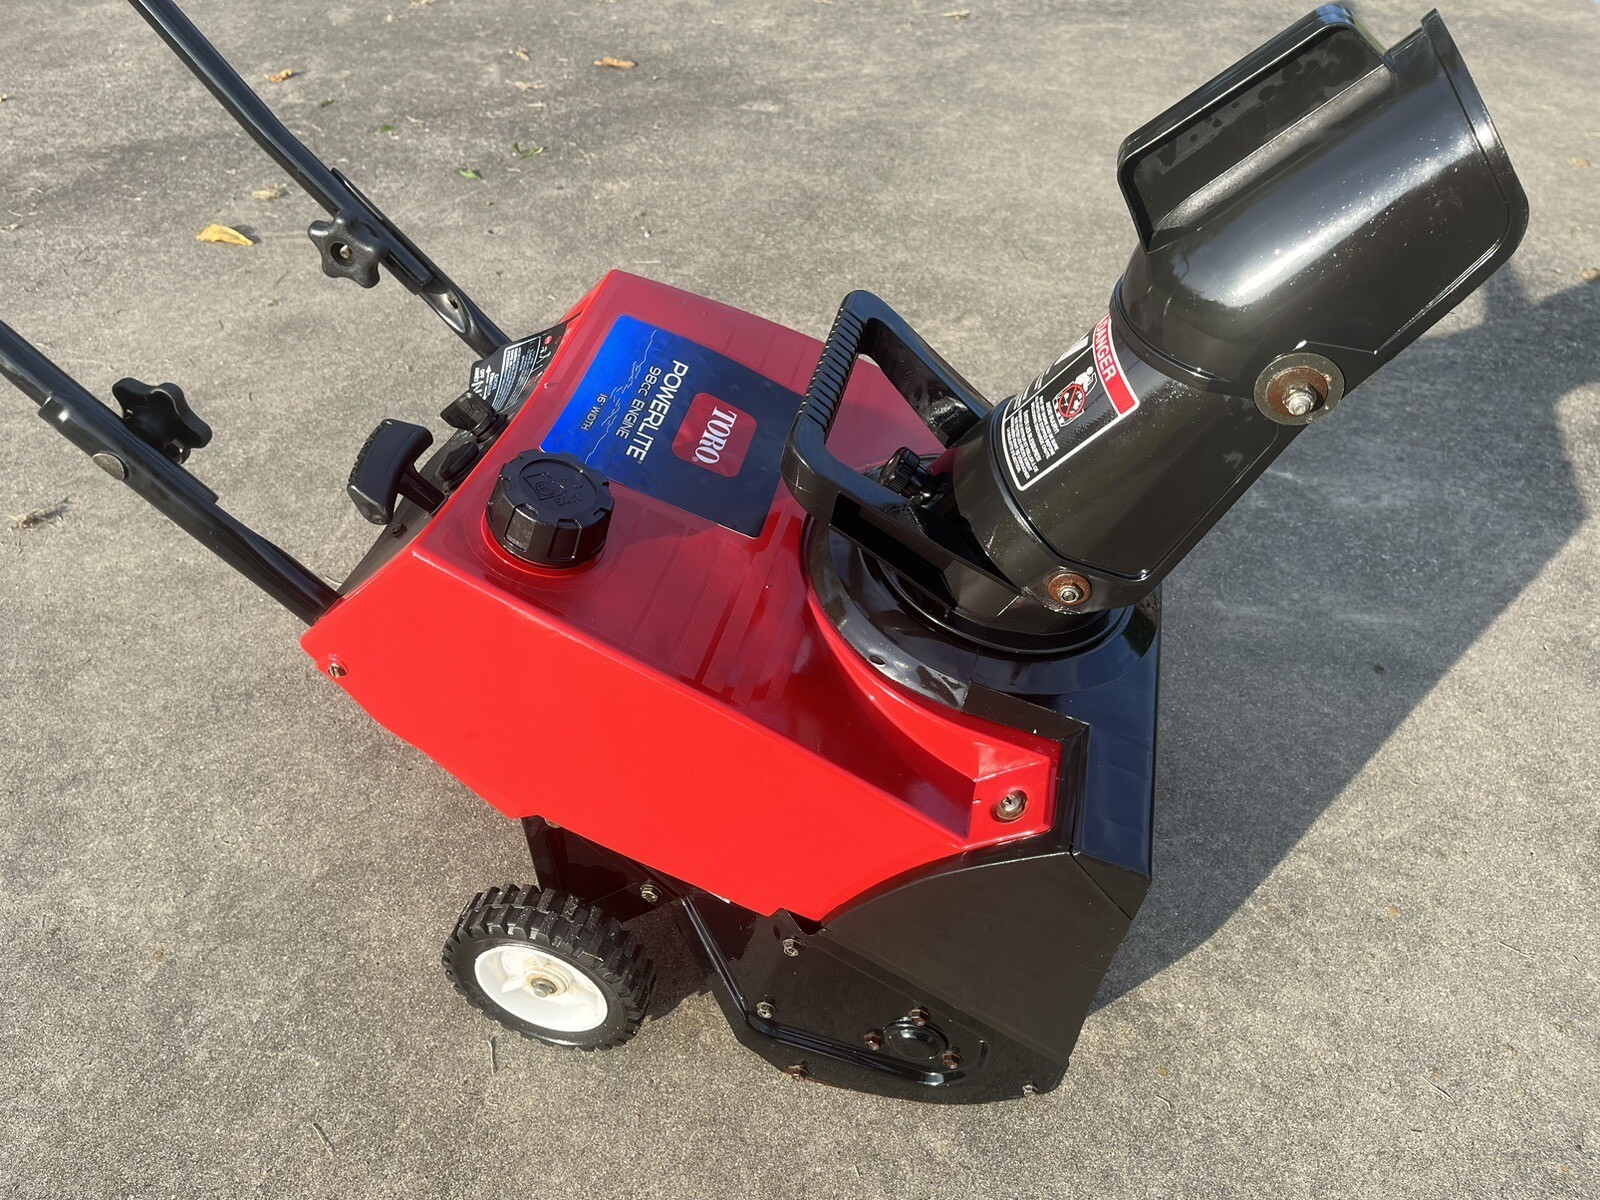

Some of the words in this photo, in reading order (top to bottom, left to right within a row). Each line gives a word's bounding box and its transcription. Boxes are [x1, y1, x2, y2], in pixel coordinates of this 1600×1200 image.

[1096, 320, 1117, 382] DANGER
[637, 365, 661, 397] 98cc
[581, 405, 601, 432] WIDTH
[616, 398, 644, 439] ENGINE
[624, 358, 690, 462] POWERLITE
[694, 406, 738, 464] TORO
